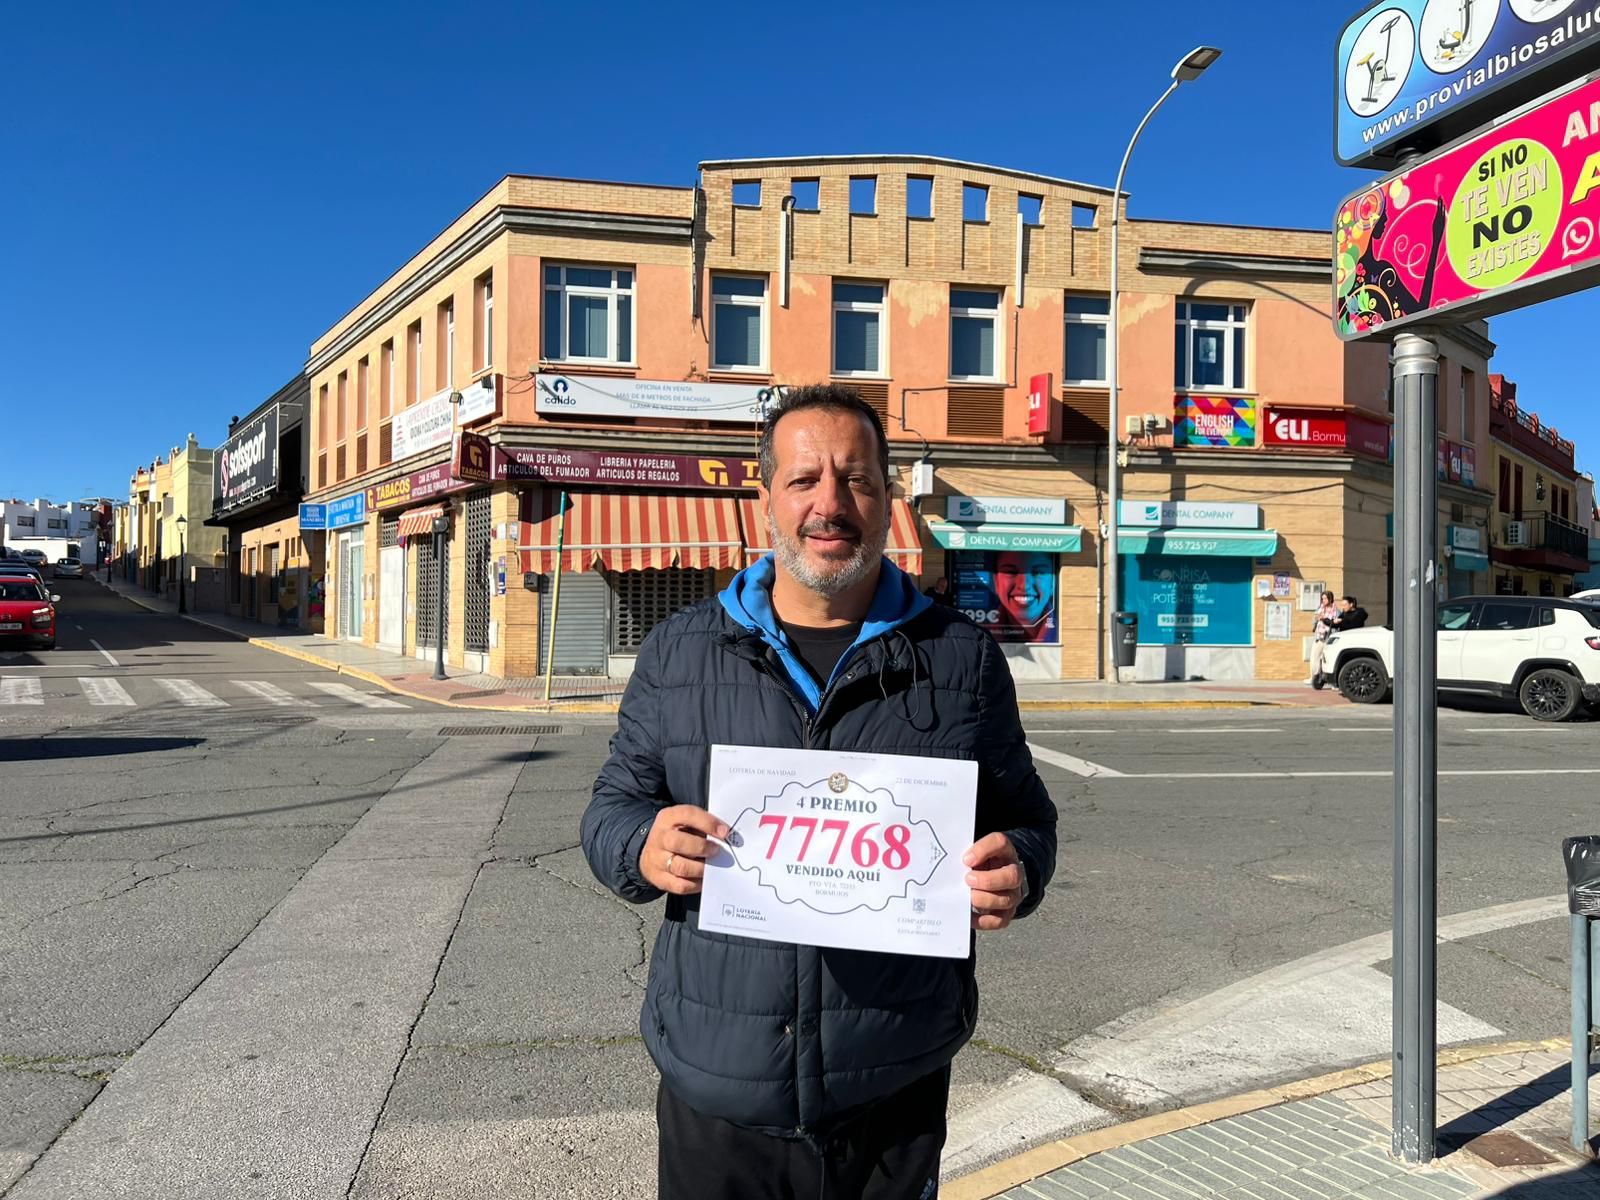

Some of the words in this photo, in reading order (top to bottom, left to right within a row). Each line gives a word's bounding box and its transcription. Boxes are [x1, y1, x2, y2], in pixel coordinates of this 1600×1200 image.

[1478, 160, 1496, 182] SI
[1501, 143, 1528, 169] NO
[1461, 184, 1489, 222] TE
[1494, 158, 1548, 209] VEN
[1472, 204, 1533, 249] NO
[1465, 230, 1542, 280] EXISTES
[673, 384, 693, 392] VENTA
[545, 395, 577, 406] calido
[1195, 413, 1234, 428] ENGLISH
[1195, 427, 1206, 436] FOR
[1312, 430, 1347, 442] Bormu
[517, 453, 535, 464] CAVA
[536, 454, 546, 464] DE
[548, 455, 572, 465] PUROS
[600, 457, 632, 468] LIBRERIA
[632, 458, 638, 468] Y
[639, 458, 676, 470] PAPELERIA
[461, 466, 489, 479] TABACOS
[497, 465, 538, 476] ARTICULOS
[540, 466, 554, 477] DEL
[555, 466, 590, 478] FUMADOR
[596, 469, 635, 480] ARTICULOS
[637, 470, 647, 480] DE
[648, 471, 680, 482] REGALOS
[742, 461, 761, 478] T
[375, 478, 411, 501] TABACOS
[976, 505, 1007, 515] DENTAL
[1009, 506, 1053, 516] COMPANY
[1162, 509, 1192, 519] DENTAL
[1193, 510, 1234, 520] COMPANY
[969, 535, 1007, 547] DENTAL
[1012, 536, 1063, 547] COMPANY
[1167, 541, 1184, 550] 955
[1153, 568, 1211, 582] SONRISA
[913, 778, 947, 787] DICIEMBRE
[810, 796, 877, 814] PREMIO
[758, 814, 911, 871] 77768
[786, 864, 844, 878] VENDIDO
[847, 868, 881, 883] AQUÍ
[815, 889, 849, 897] BORMUJOS
[736, 913, 767, 921] NACIONAL
